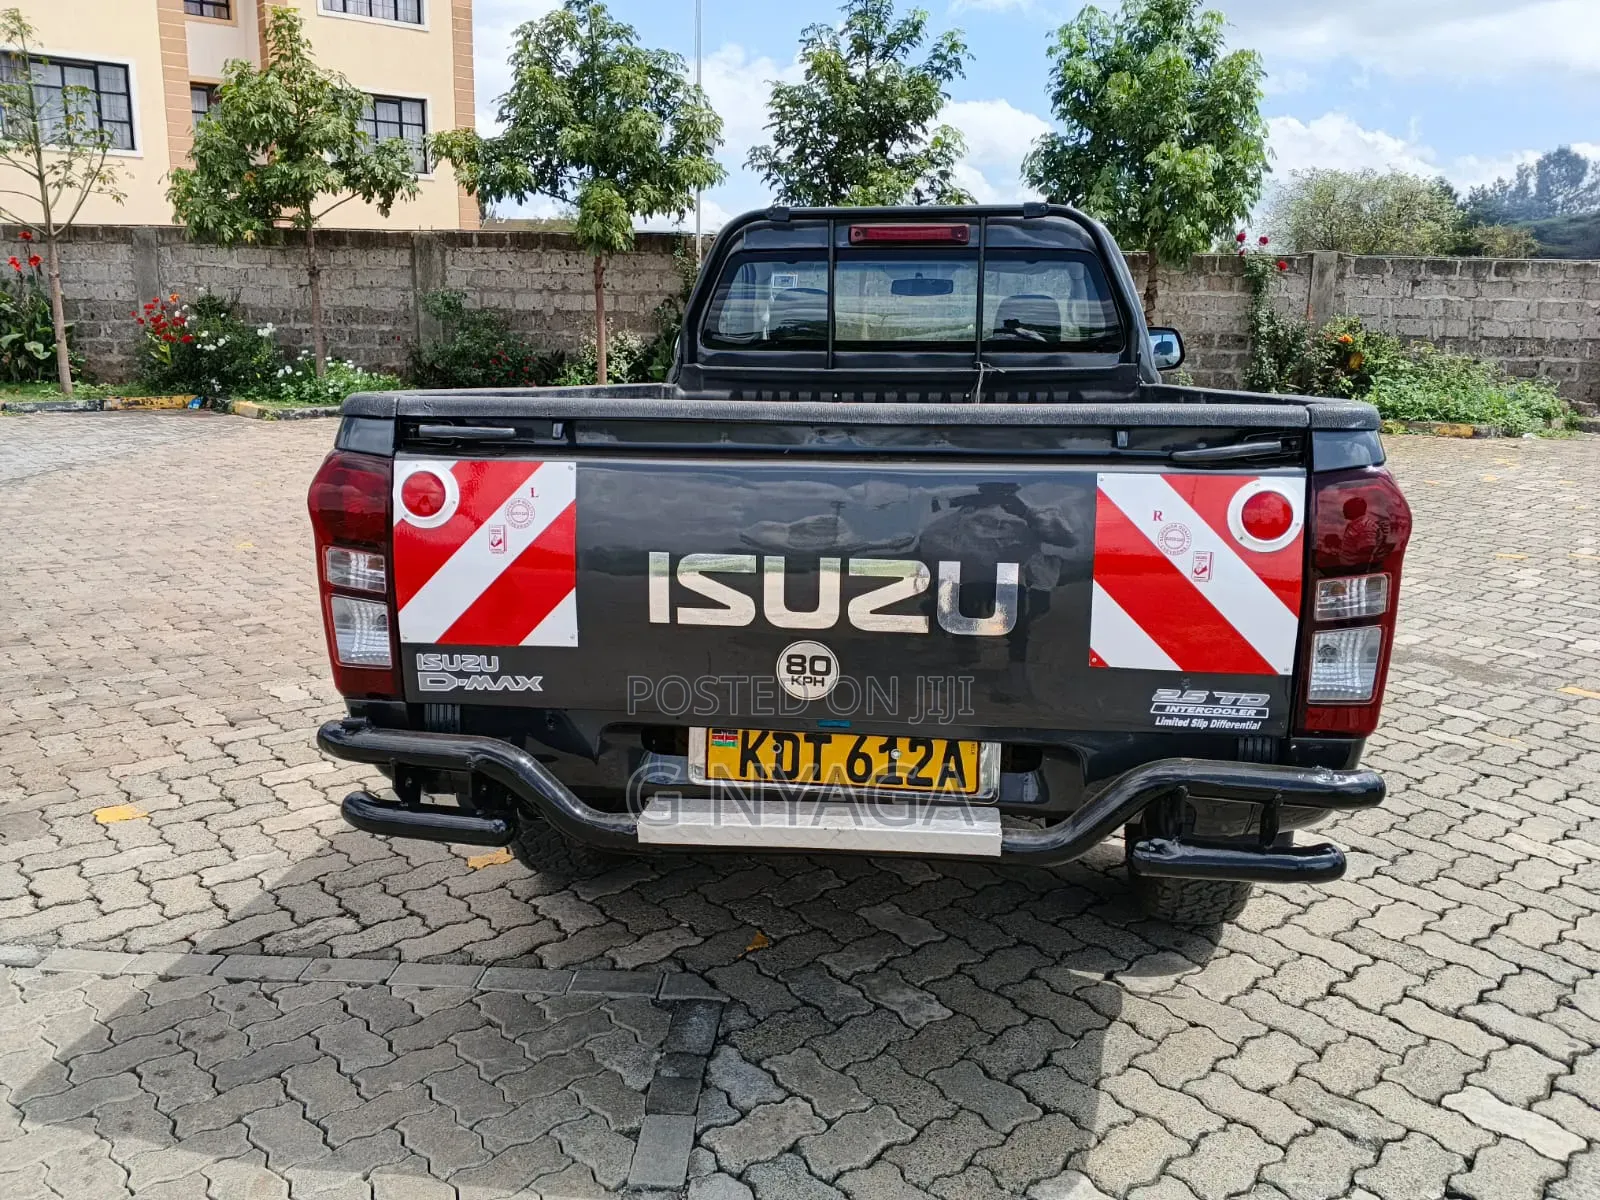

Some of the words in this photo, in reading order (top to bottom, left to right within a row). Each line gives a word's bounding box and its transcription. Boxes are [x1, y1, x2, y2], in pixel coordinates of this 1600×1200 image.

[530, 487, 540, 498] L
[1152, 509, 1164, 521] R
[648, 551, 1020, 636] ISUZU
[416, 653, 499, 672] ISUZU
[786, 654, 832, 676] 80
[417, 672, 543, 691] D-MAX
[791, 675, 825, 687] KPH
[1212, 691, 1270, 707] TD
[1164, 705, 1257, 716] INTERCOOLER
[1155, 716, 1189, 728] Limited
[1190, 718, 1208, 730] Slip
[1209, 719, 1262, 730] Differential
[739, 730, 833, 782] KDT
[845, 736, 967, 789] 612A
